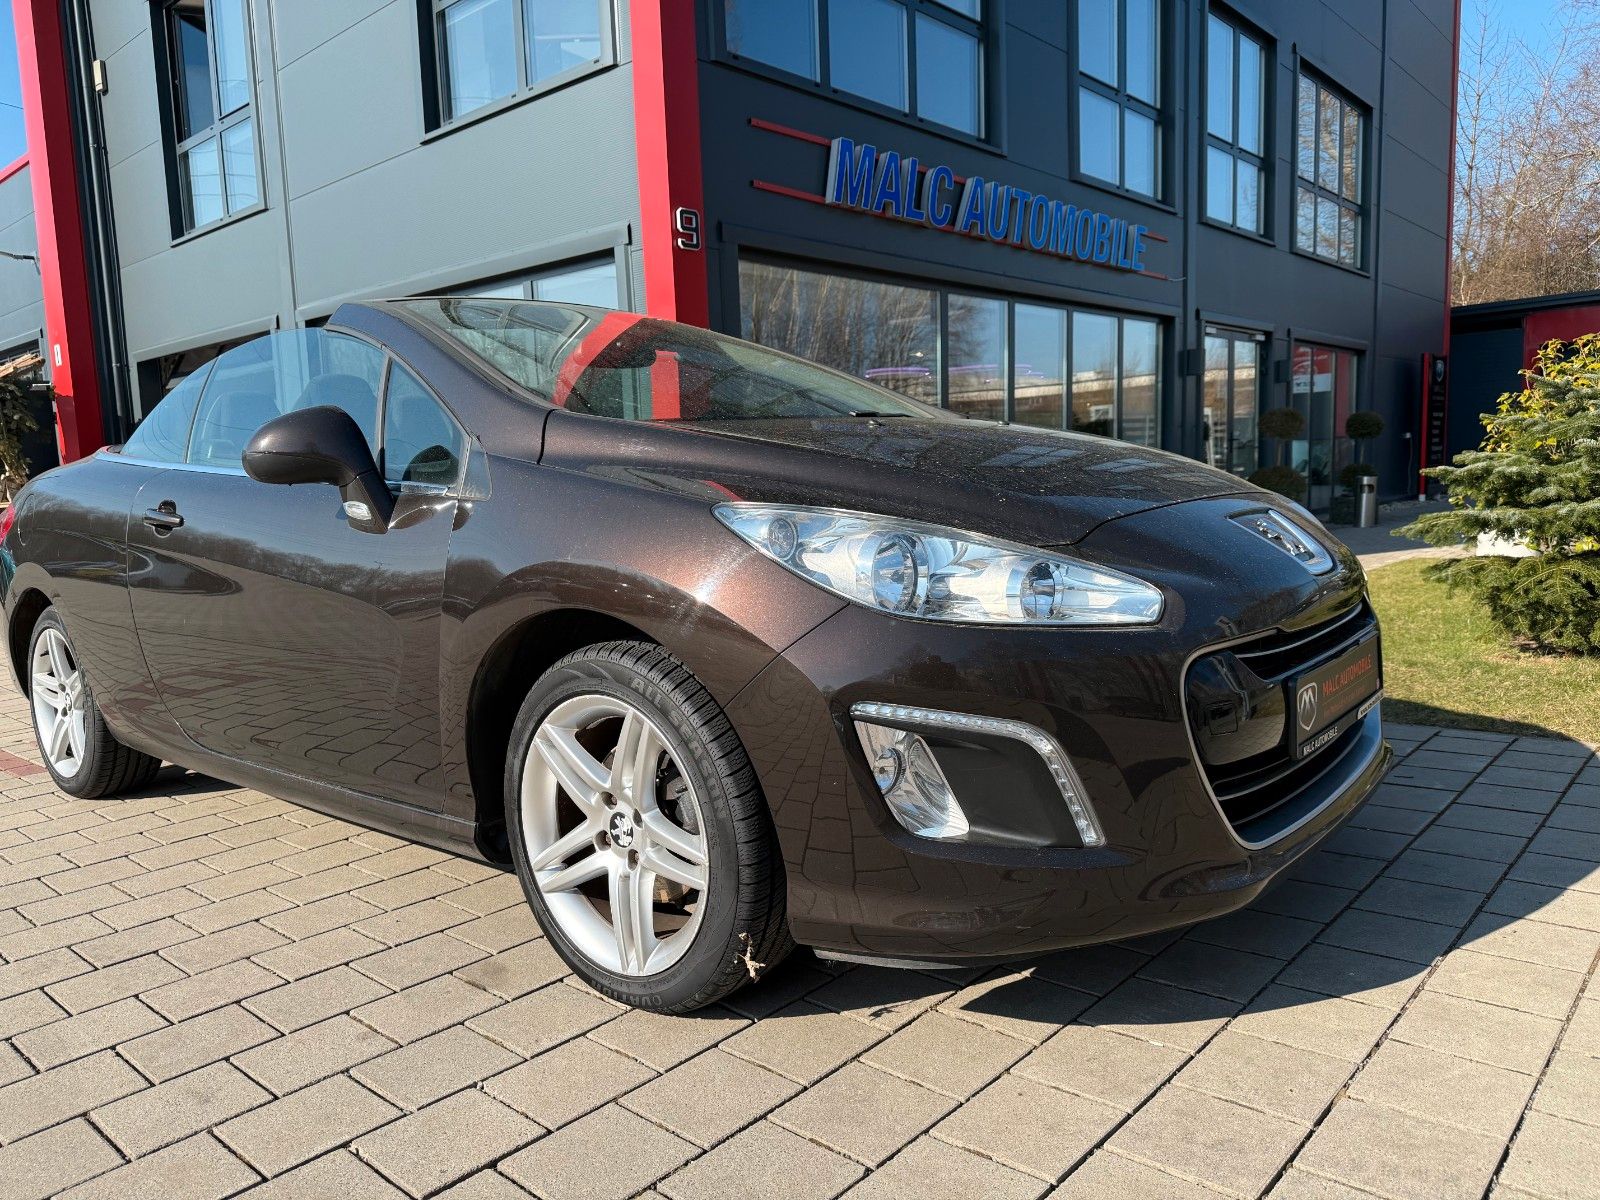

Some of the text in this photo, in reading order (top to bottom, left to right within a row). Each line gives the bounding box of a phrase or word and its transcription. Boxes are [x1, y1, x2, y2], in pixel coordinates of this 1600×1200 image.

[826, 136, 1148, 272] MALC AUTOMOBILE
[676, 206, 702, 251] 9
[1322, 674, 1341, 696] MALC
